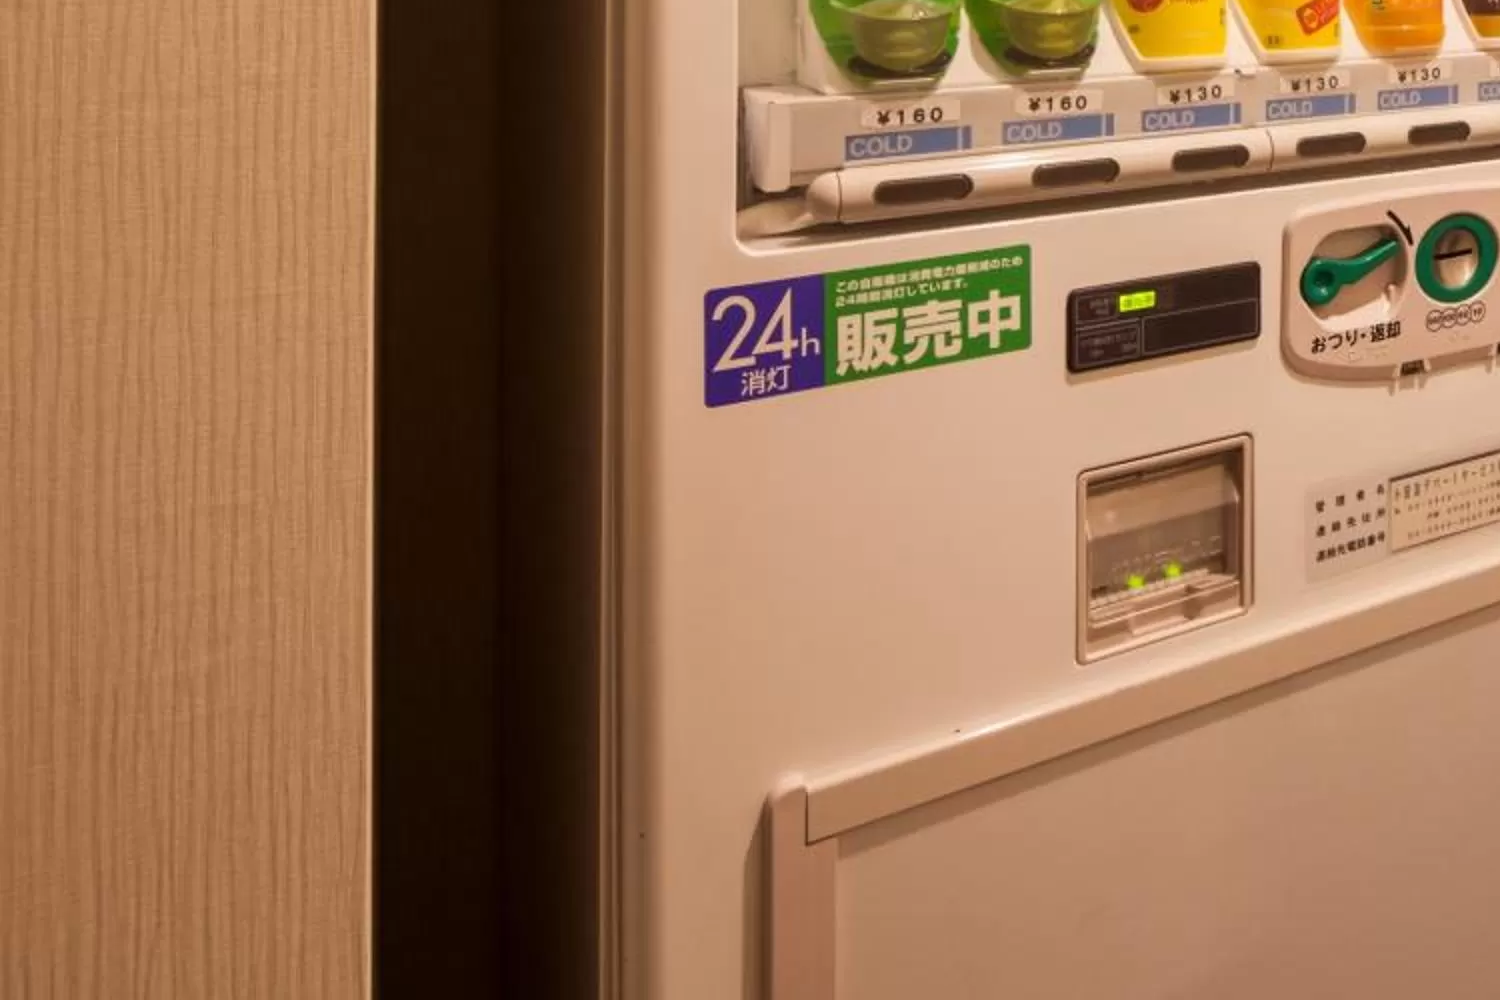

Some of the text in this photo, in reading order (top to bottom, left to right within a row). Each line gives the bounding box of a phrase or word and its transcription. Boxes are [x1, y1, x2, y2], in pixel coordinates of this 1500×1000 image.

[1291, 75, 1340, 93] ¥130
[1398, 67, 1441, 83] ¥130
[1028, 95, 1088, 113] ¥160
[1168, 84, 1223, 105] ¥130
[1379, 90, 1421, 108] COLD
[876, 106, 944, 126] ¥160
[1144, 109, 1196, 130] COLD
[1267, 100, 1313, 119] COLD
[1006, 121, 1063, 143] COLD
[849, 135, 914, 158] COLD
[835, 288, 1021, 377] 販売中
[1311, 321, 1401, 354] おつり・返却
[740, 364, 791, 396] 消灯
